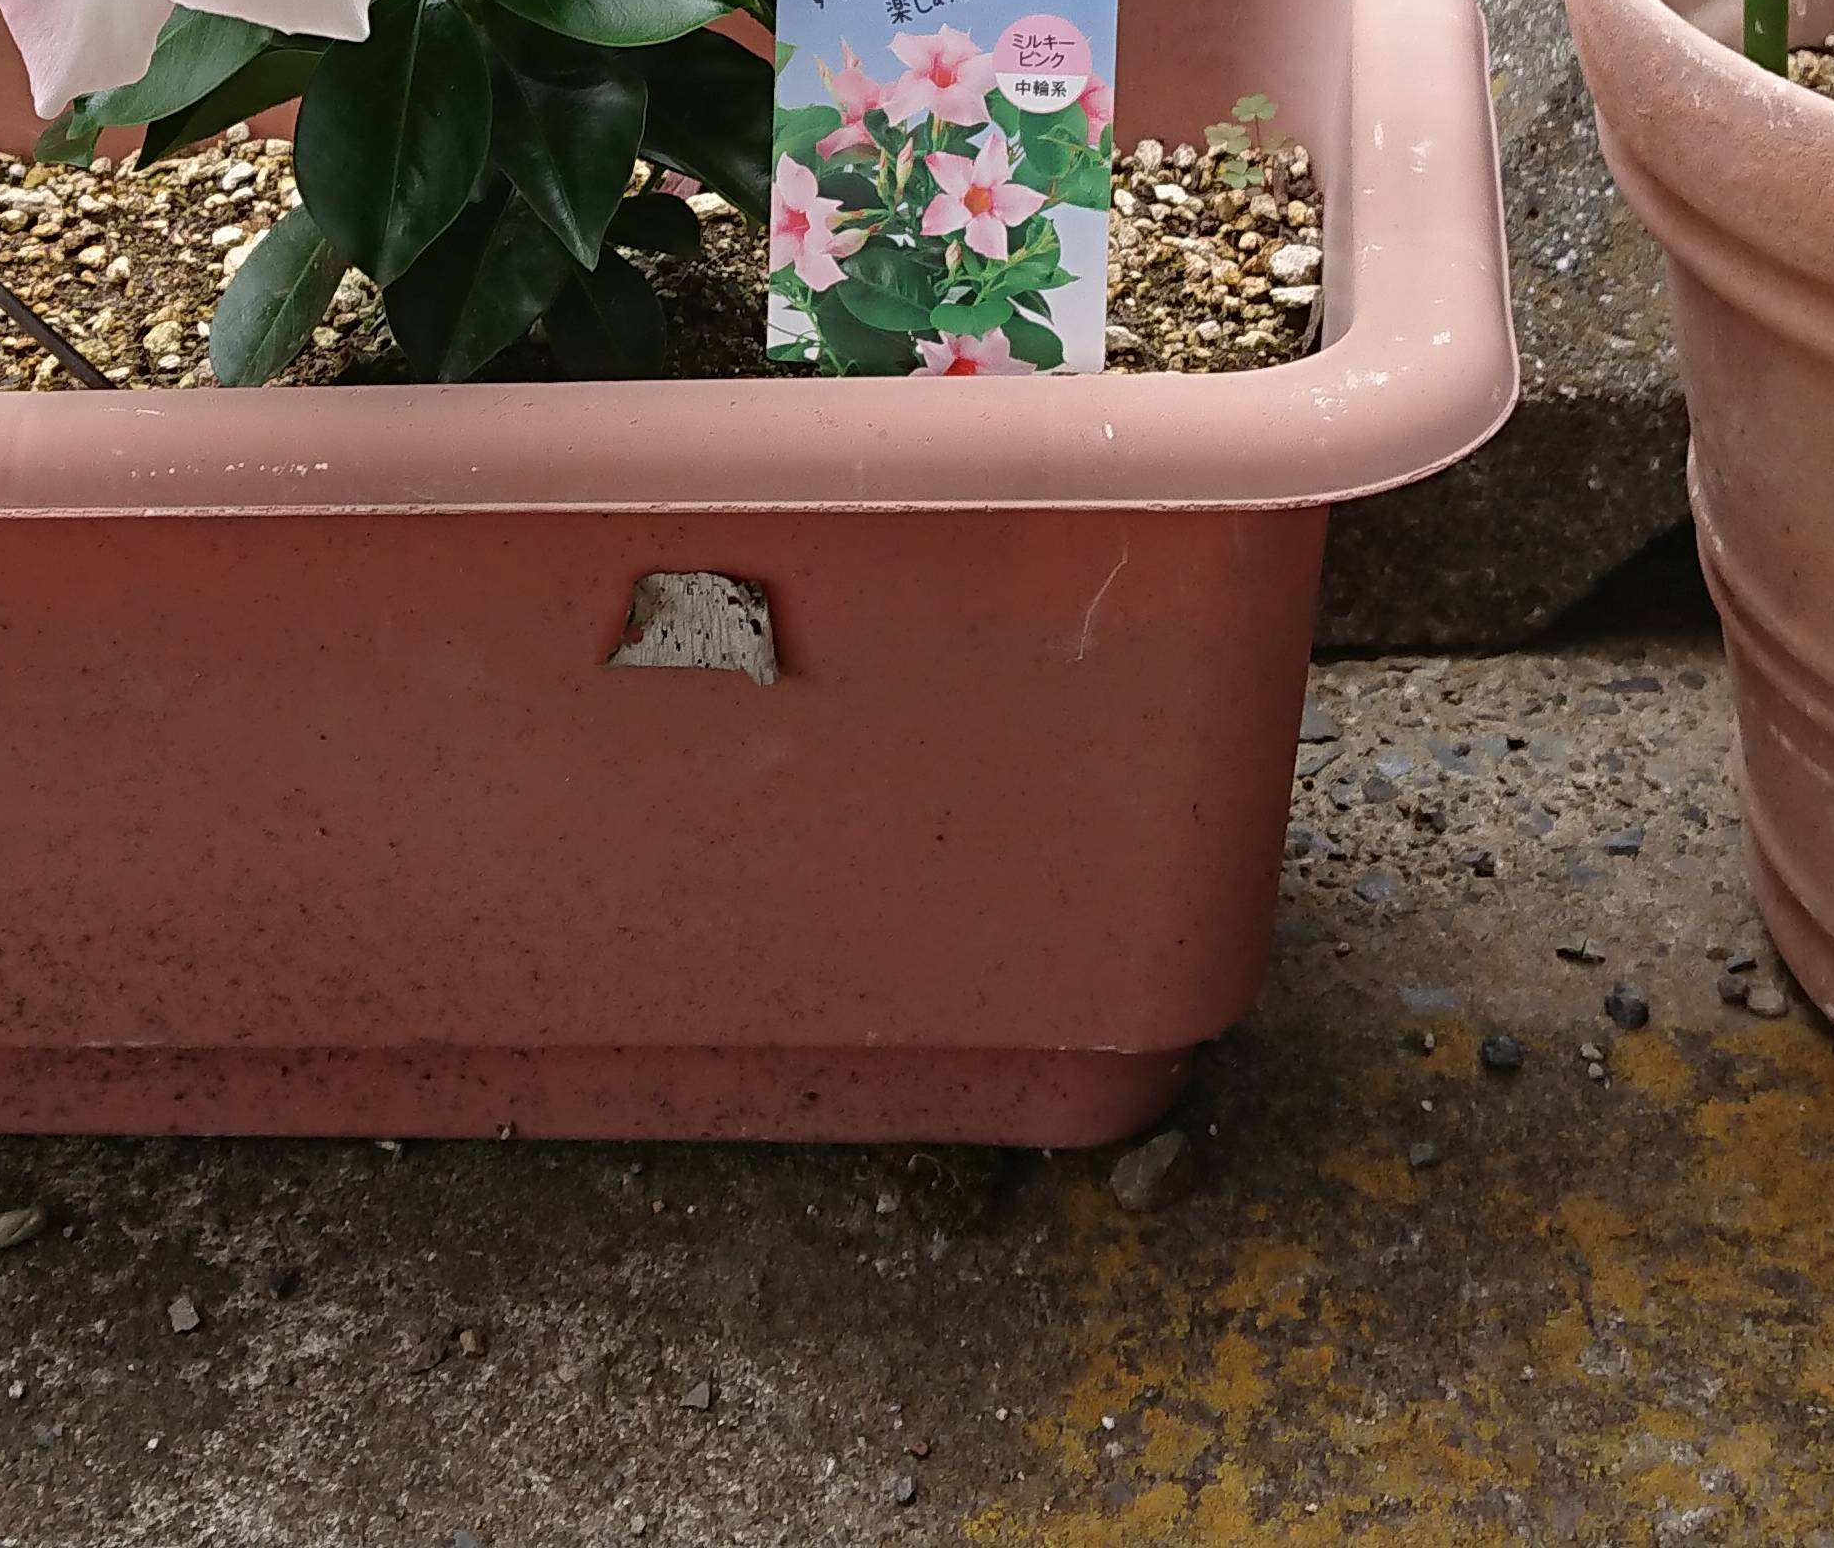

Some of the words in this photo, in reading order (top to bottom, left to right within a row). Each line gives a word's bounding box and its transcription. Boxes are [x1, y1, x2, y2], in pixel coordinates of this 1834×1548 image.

[1011, 32, 1075, 51] ミルキー
[1018, 50, 1066, 69] ピンク
[1014, 79, 1068, 99] 中輪系
